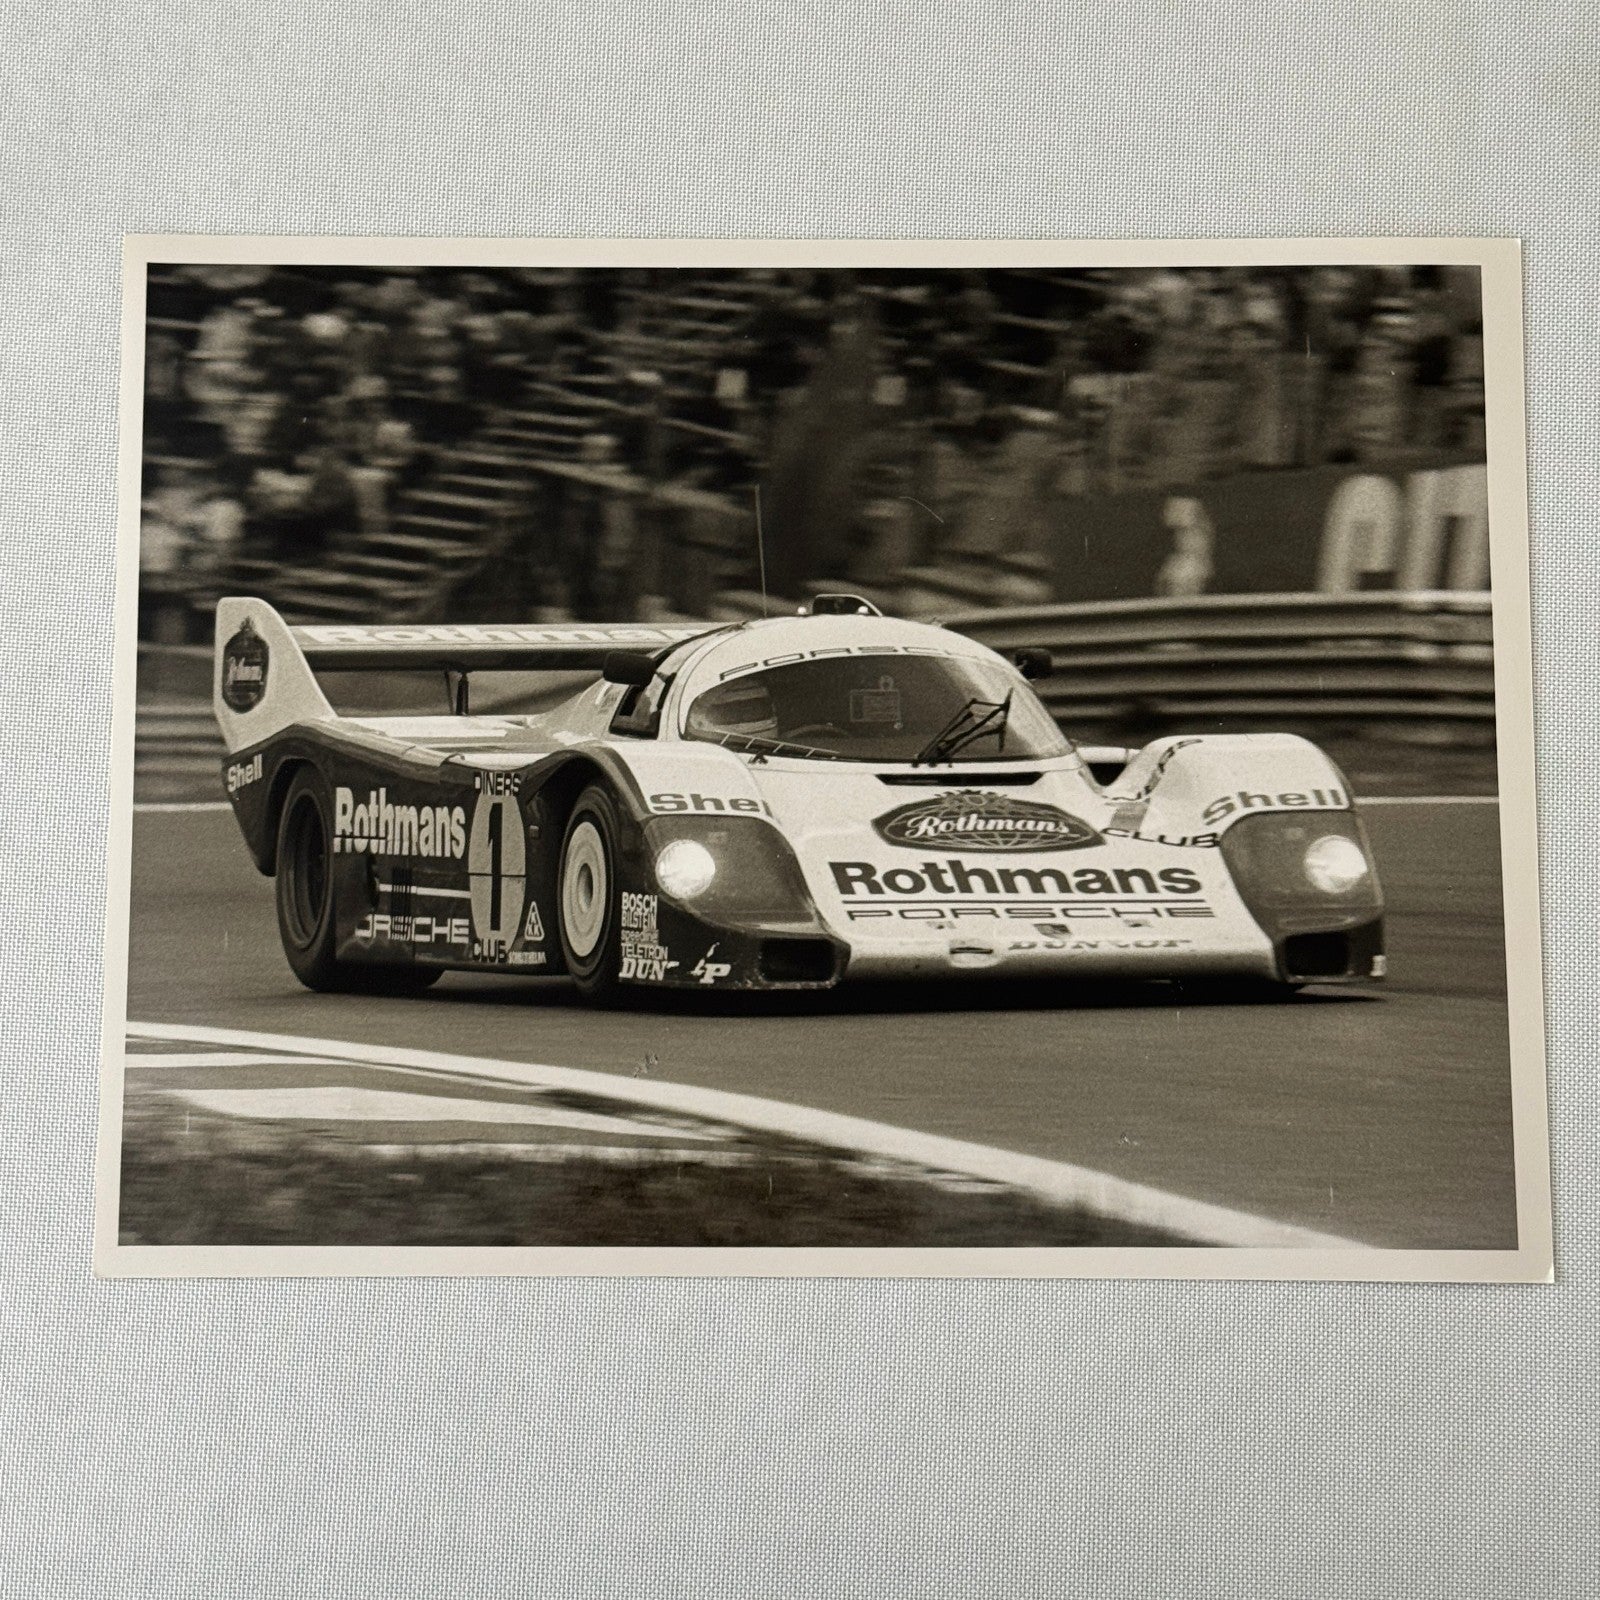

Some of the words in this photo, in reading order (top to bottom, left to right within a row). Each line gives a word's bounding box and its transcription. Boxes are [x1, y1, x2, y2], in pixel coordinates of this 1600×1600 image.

[302, 626, 710, 645] Rothma
[227, 754, 263, 793] Shell
[475, 771, 522, 797] DINERS
[1203, 788, 1344, 825] Shell
[333, 786, 466, 859] Rothmans
[905, 813, 1079, 836] Rothmans
[1101, 827, 1221, 848] CLUB
[488, 803, 503, 931] 1
[828, 860, 1203, 896] Rothmans
[621, 891, 658, 915] BOSCH
[846, 906, 1216, 921] PORSCHE
[472, 938, 508, 963] CLUB
